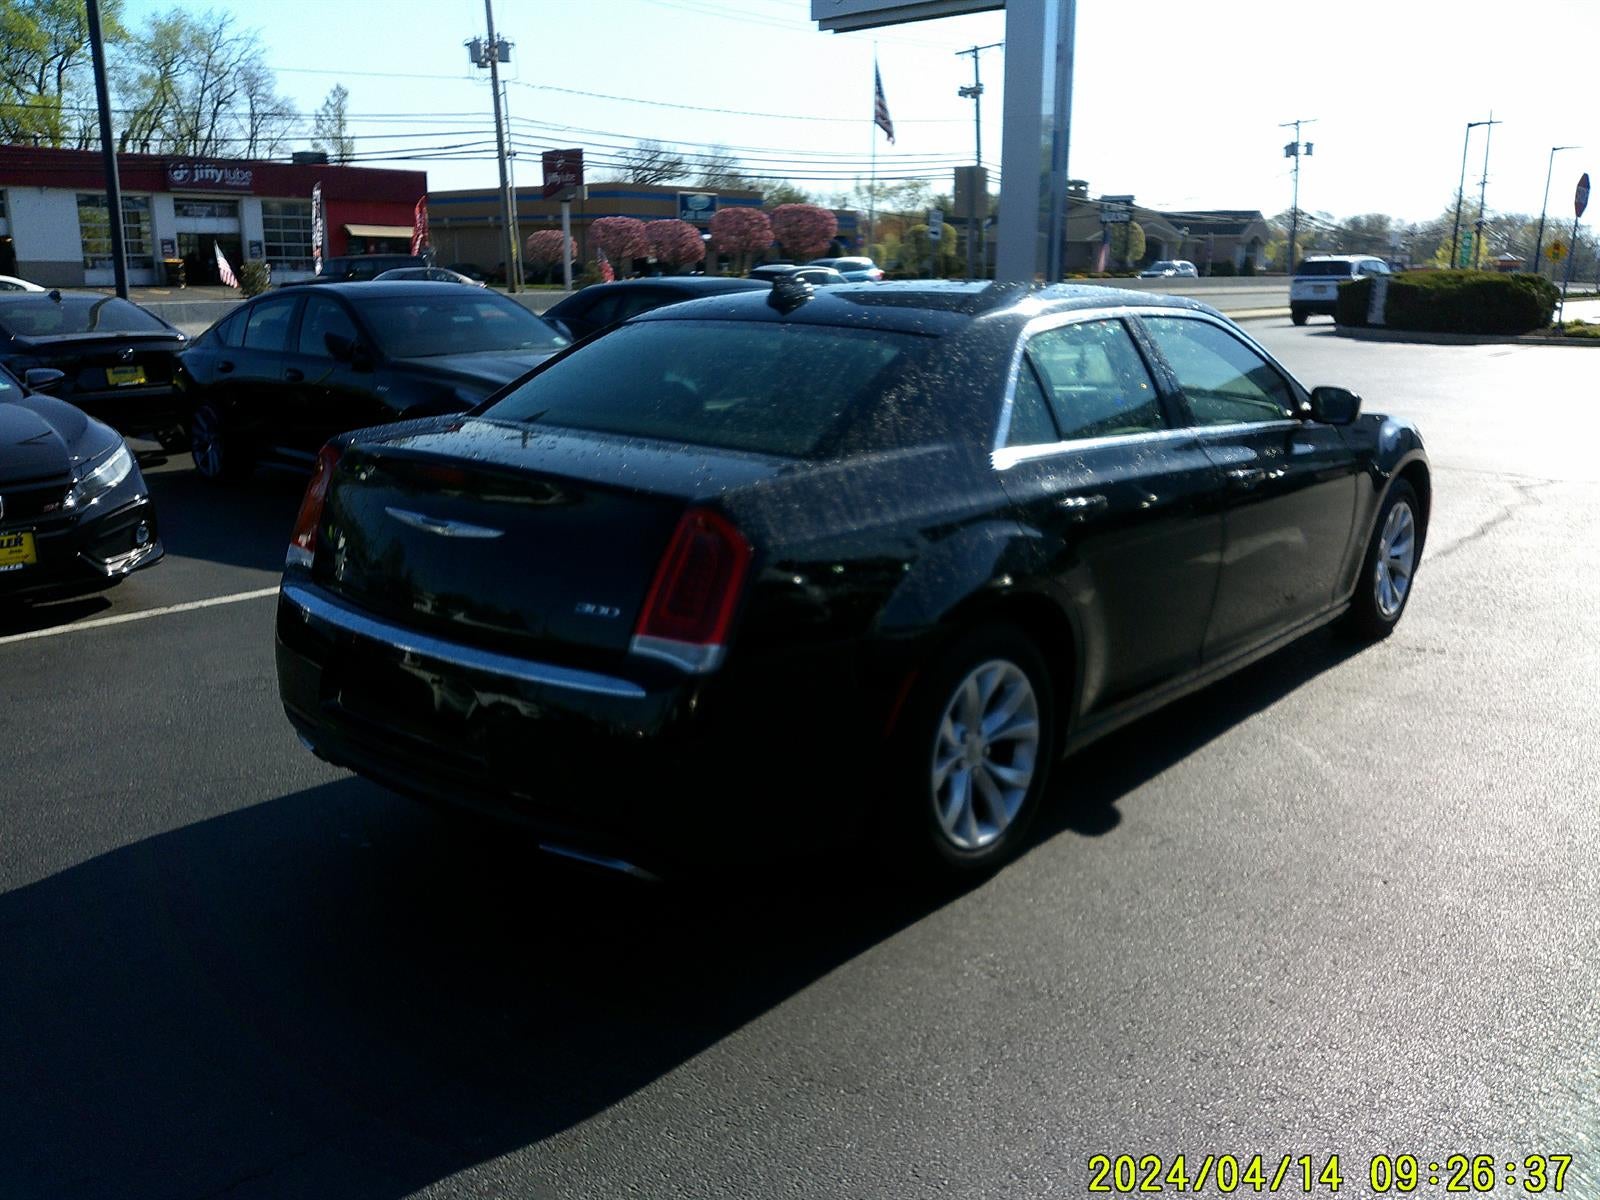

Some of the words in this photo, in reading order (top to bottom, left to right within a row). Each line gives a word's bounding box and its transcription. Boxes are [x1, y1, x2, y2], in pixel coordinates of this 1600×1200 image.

[193, 163, 223, 183] jiffy
[224, 167, 254, 181] lube
[575, 602, 620, 617] 300
